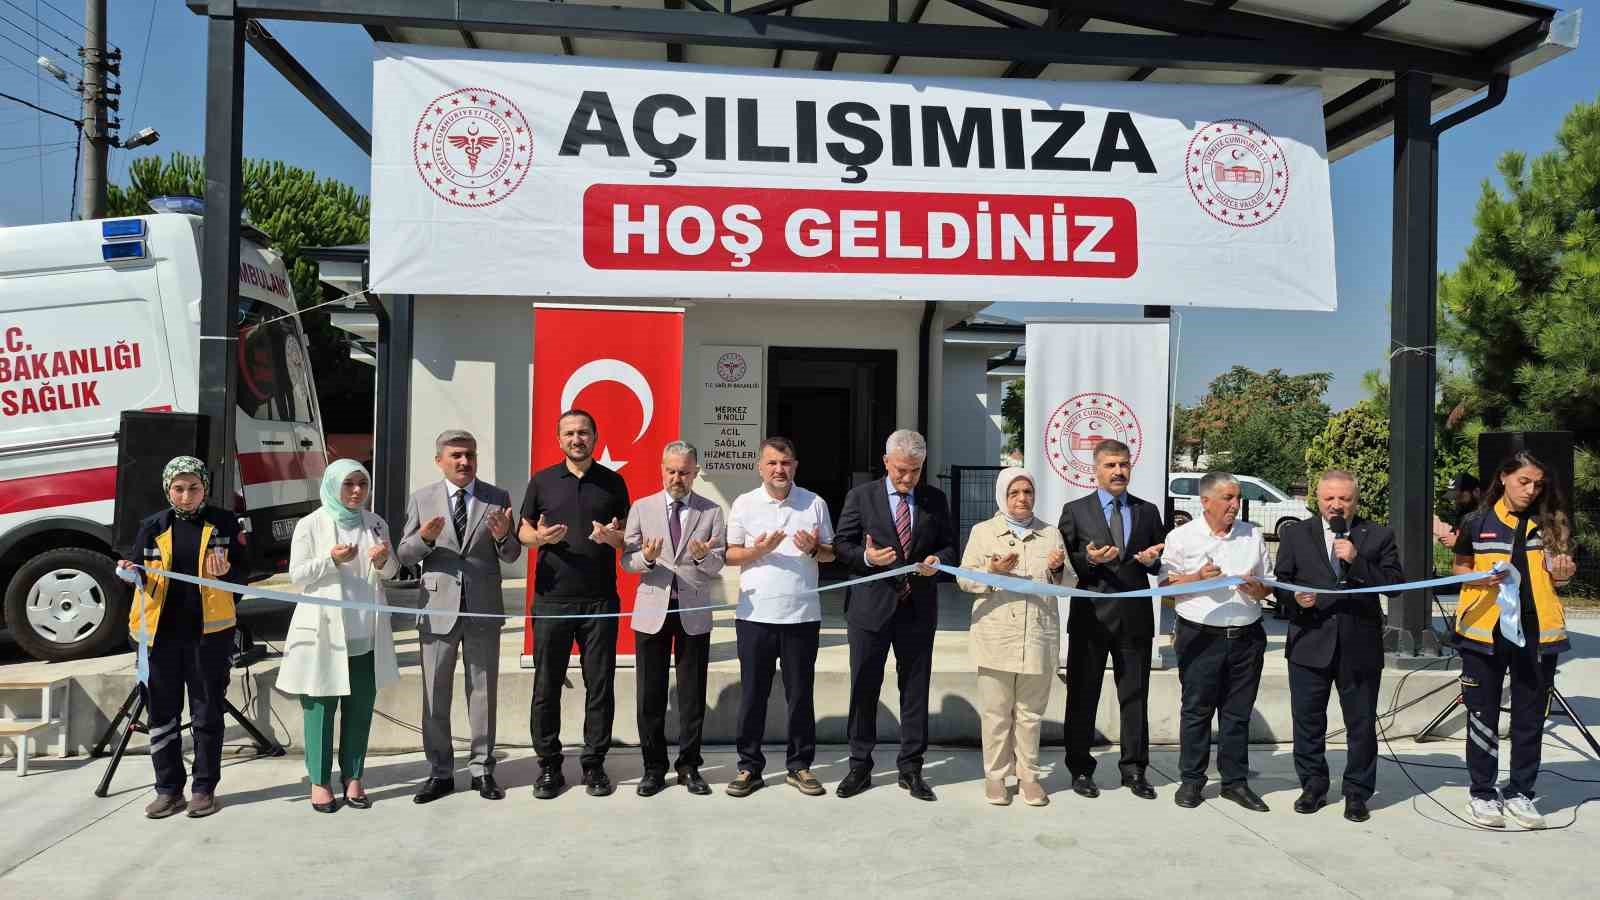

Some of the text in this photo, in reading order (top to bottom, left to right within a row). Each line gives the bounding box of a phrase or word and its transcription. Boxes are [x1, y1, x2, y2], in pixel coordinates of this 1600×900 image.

[558, 90, 1156, 183] AÇILIŞIMIZA
[612, 200, 1116, 267] HOŞ GELDİNİZ
[0, 339, 141, 383] BAKANLIĞI
[1, 380, 101, 416] SAĞLIK
[715, 406, 748, 414] MERKEZ
[723, 413, 745, 421] NOLU
[714, 438, 746, 448] SAĞLIK
